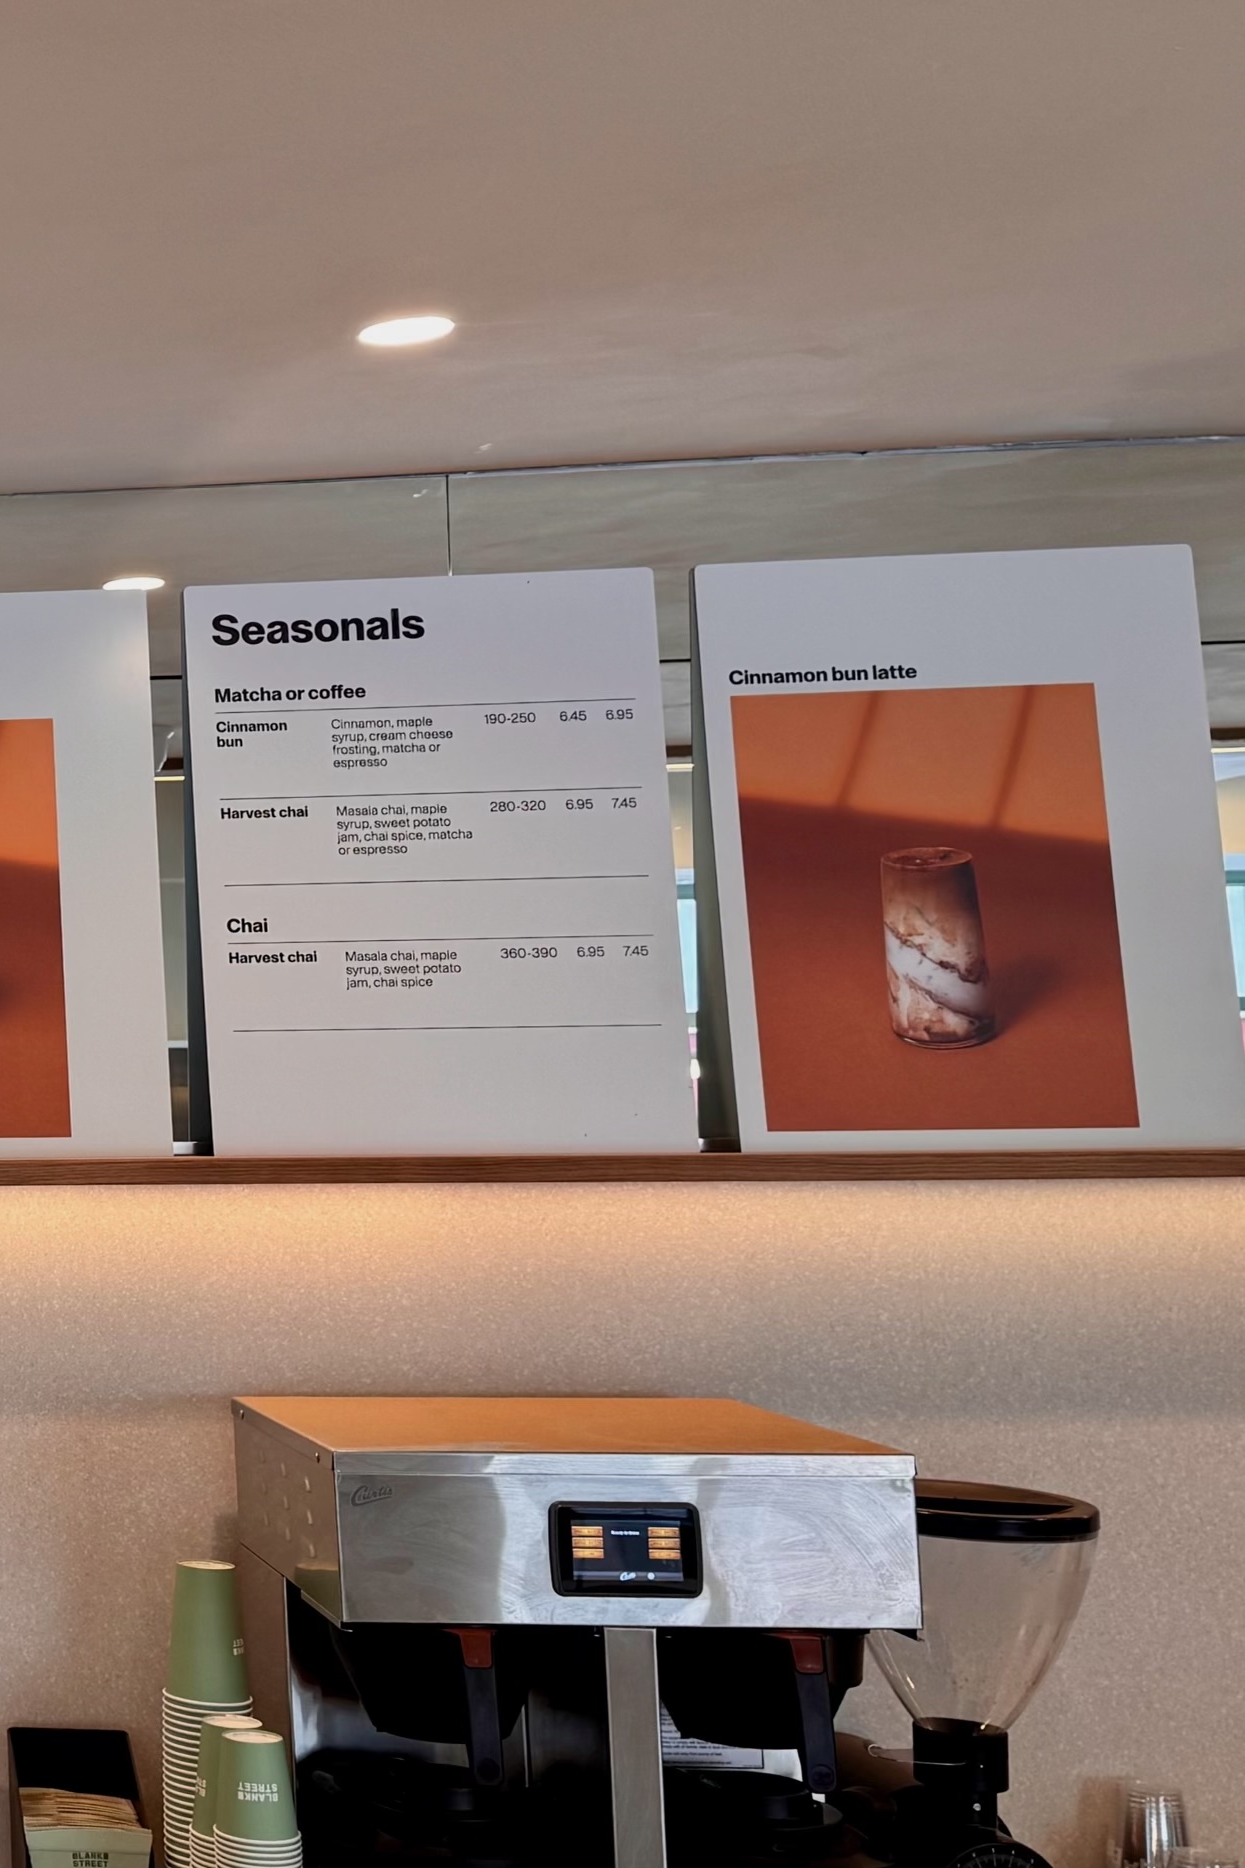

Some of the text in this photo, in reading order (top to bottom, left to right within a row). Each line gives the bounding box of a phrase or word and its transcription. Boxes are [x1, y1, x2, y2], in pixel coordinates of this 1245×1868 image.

[212, 608, 425, 646] Seasonals
[728, 664, 918, 686] Cinnamon bun latte
[214, 683, 367, 704] Matcha or coffee
[330, 716, 434, 730] Cinnamon, maple
[483, 708, 634, 725] 190-250 6.45 6.95
[215, 720, 288, 734] Cinnamon
[216, 735, 244, 748] bun
[331, 729, 454, 745] syrup, cream cheese
[332, 742, 427, 757] frosting, matcha
[332, 757, 388, 770] espresso
[220, 805, 309, 820] Harvest chai
[335, 803, 448, 817] Masala chai, maple
[489, 796, 638, 813] 280-320 6.95 7.45
[336, 817, 452, 835] syrup, sweet potato
[336, 828, 474, 845] jam, chai spice, matcha
[352, 845, 409, 857] espresso
[226, 917, 269, 934] Chai
[228, 949, 318, 965] Harvest chai
[500, 944, 649, 960] 360-390 6.95 7.45
[350, 1484, 392, 1506] Curtis
[237, 1781, 278, 1793] STREET
[72, 1860, 108, 1868] STREET
